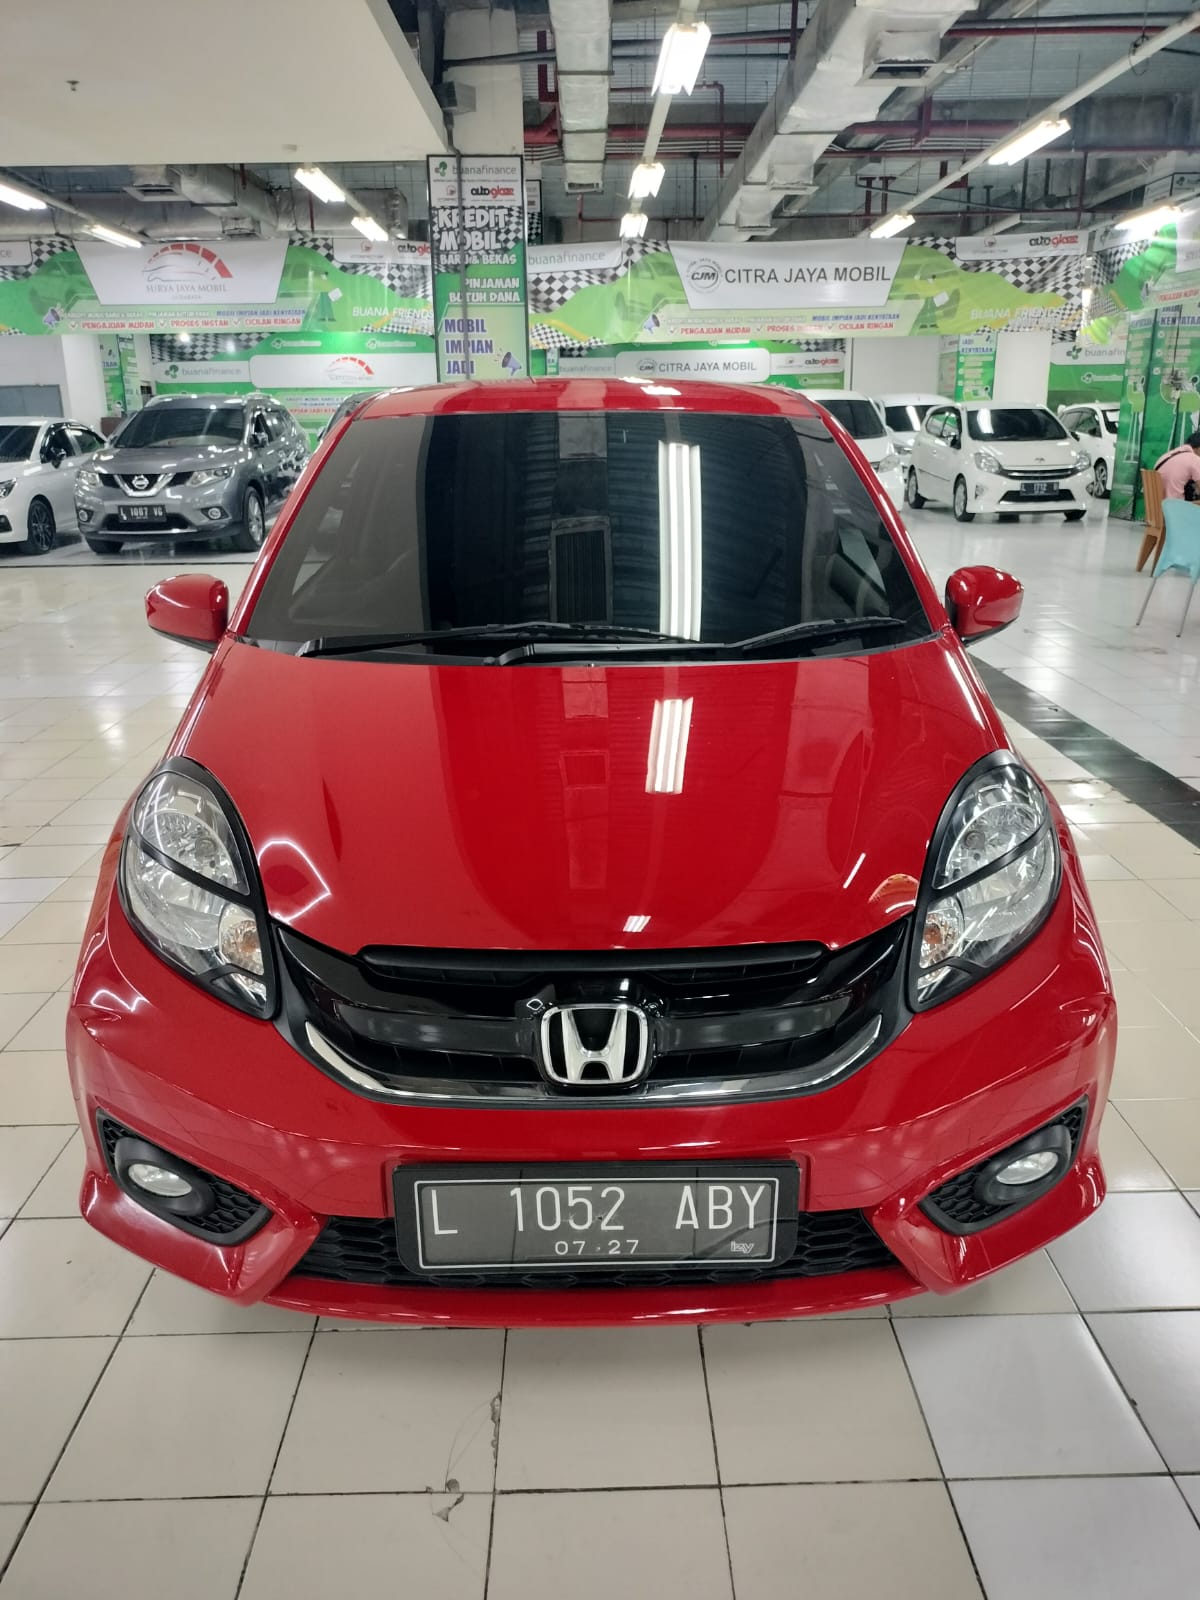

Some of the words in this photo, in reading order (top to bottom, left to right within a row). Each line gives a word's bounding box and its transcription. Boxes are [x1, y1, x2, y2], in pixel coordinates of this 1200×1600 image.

[438, 208, 508, 229] KREDIT
[440, 231, 501, 251] MOBIL
[482, 254, 517, 265] BEKAS
[528, 250, 606, 266] buanafinance
[724, 268, 779, 284] CITRA
[784, 266, 828, 283] JAYA
[833, 266, 891, 282] MOBIL
[490, 292, 520, 303] DANA
[352, 306, 389, 317] BUANA
[170, 320, 200, 328] PROSES
[444, 319, 487, 333] MOBIL
[445, 340, 493, 354] IMPIAN
[659, 363, 690, 372] CITRA
[694, 362, 720, 372] JAYA
[723, 361, 756, 371] MOBIL
[431, 1189, 458, 1235] L
[510, 1186, 625, 1232] 1052
[675, 1185, 765, 1230] ABY
